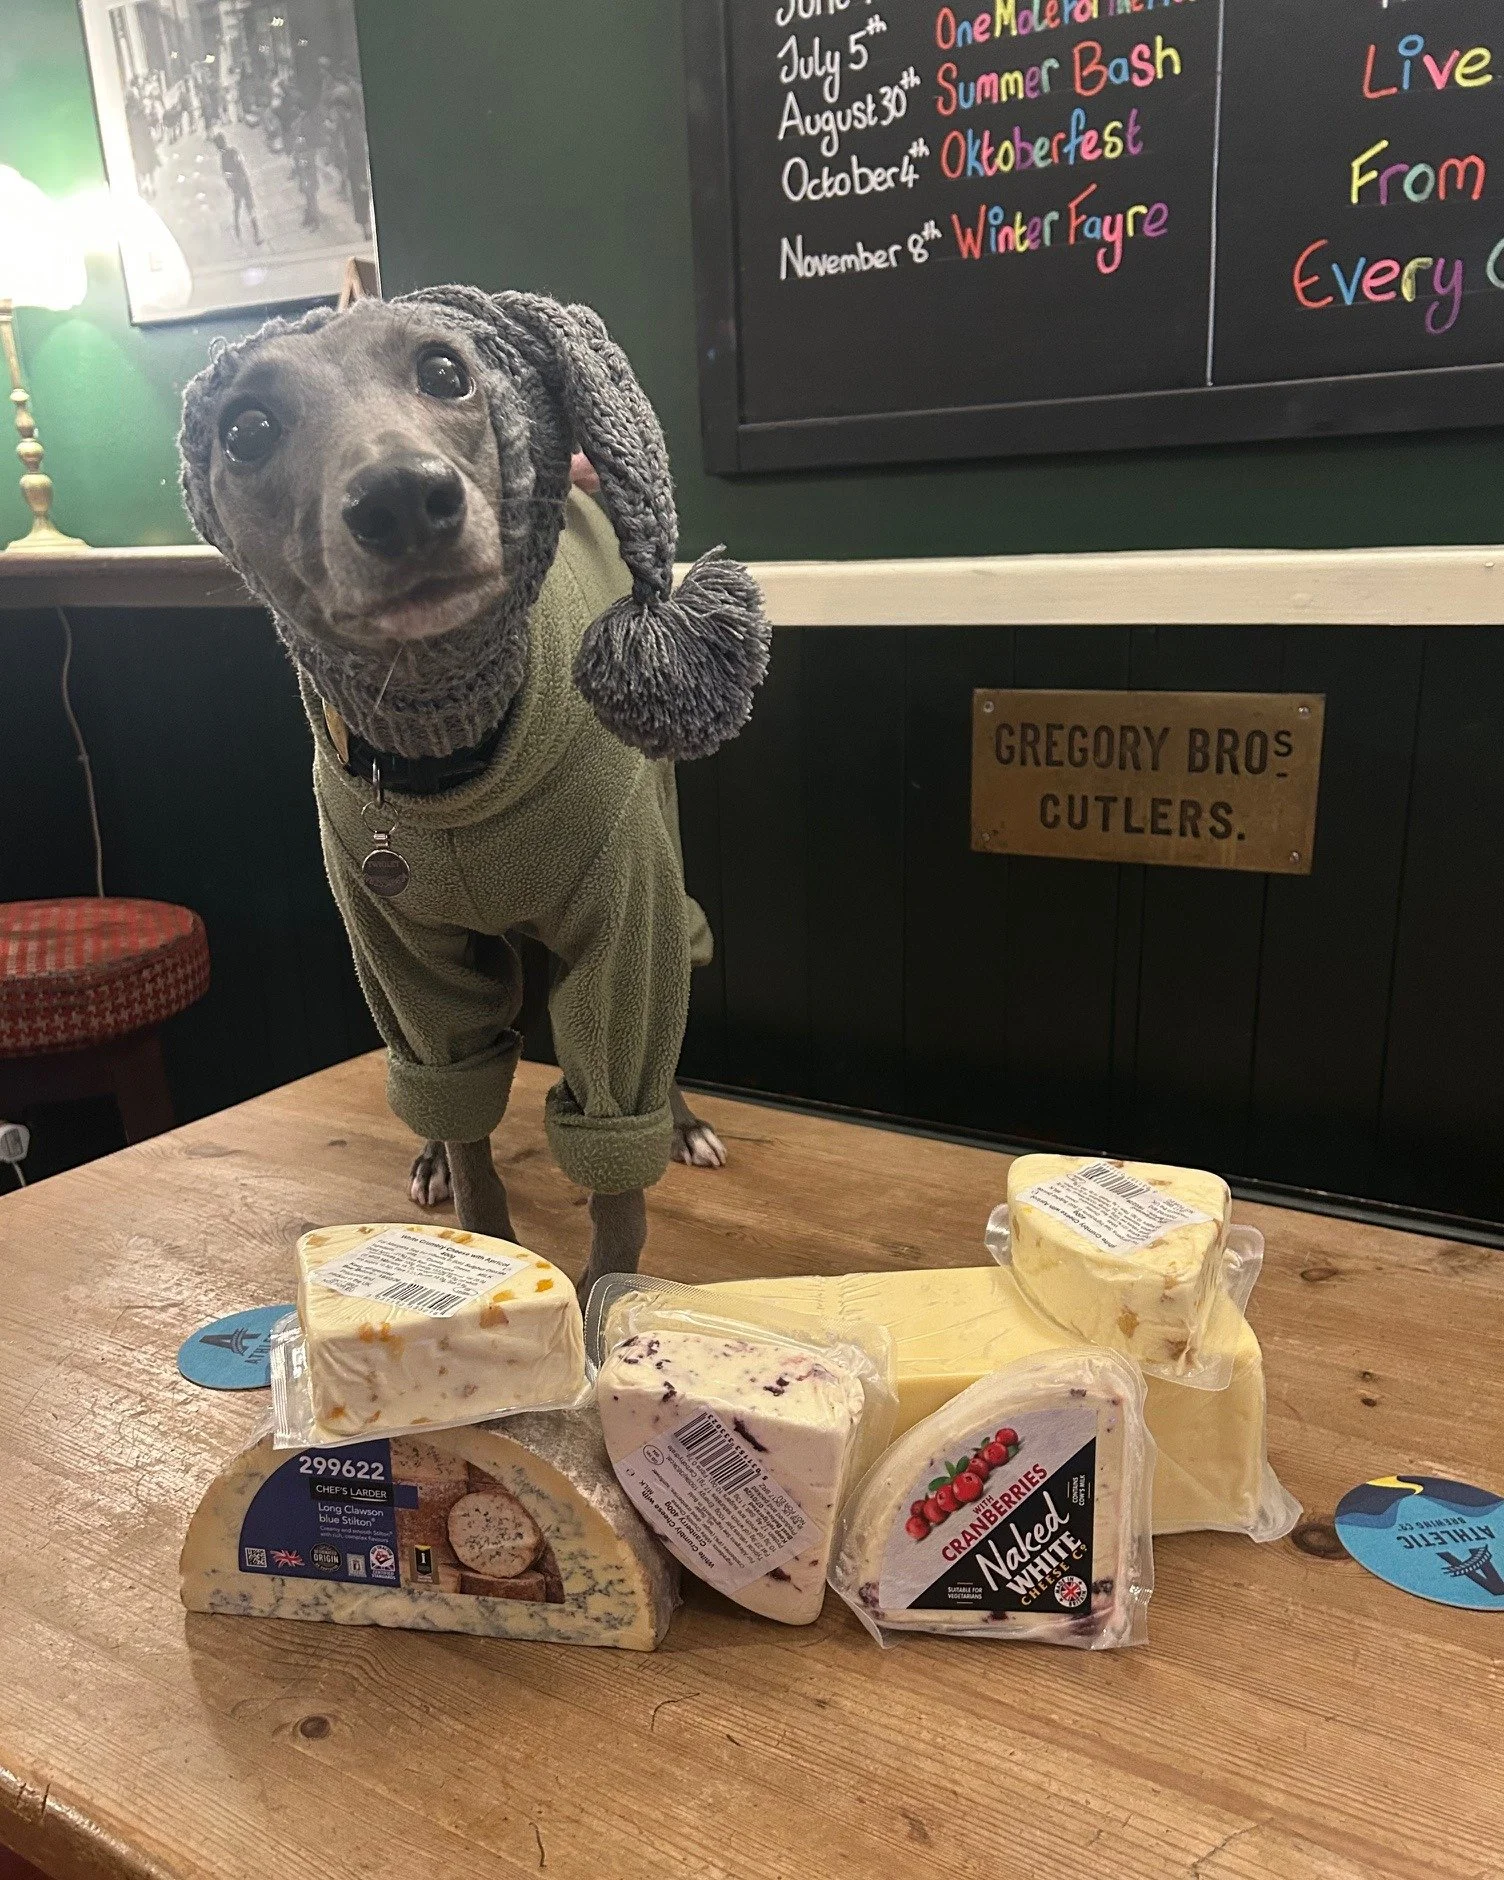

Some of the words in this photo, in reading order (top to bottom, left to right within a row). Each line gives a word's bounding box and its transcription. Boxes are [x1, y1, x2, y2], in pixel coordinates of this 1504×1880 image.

[777, 35, 841, 103] July
[936, 7, 991, 50] One
[1363, 34, 1492, 99] Live
[778, 91, 878, 157] August
[937, 62, 1060, 116] Summer
[1073, 35, 1182, 97] Bash
[782, 155, 899, 201] October
[941, 108, 1144, 178] Oktoberfest
[1350, 139, 1486, 205] From
[780, 235, 901, 280] November
[907, 220, 942, 264] 8th
[951, 204, 1059, 260] Winter
[1068, 184, 1168, 274] Fayre
[1293, 239, 1463, 334] Every
[995, 723, 1171, 771] GREGORY
[1040, 793, 1246, 841] CUTLERS.
[299, 1456, 385, 1480] 299622
[316, 1484, 348, 1495] CHEF'S
[350, 1488, 387, 1499] LARDER
[639, 1489, 656, 1505] with
[972, 1495, 994, 1515] WITH
[318, 1502, 342, 1515] Long
[344, 1505, 384, 1517] Clawson
[319, 1514, 340, 1524] blue
[652, 1503, 676, 1528] Cheese
[662, 1500, 681, 1518] 400g
[942, 1463, 1048, 1561] CRANBERRIES
[1415, 1516, 1467, 1529] BREWING
[672, 1525, 700, 1552] Crumbly
[677, 1516, 708, 1547] Cranberry
[773, 1528, 788, 1543] Keep
[975, 1490, 1070, 1592] Naked
[1396, 1525, 1496, 1549] ATHLETIC
[314, 1553, 339, 1563] ORIGIN
[696, 1550, 715, 1569] White
[1006, 1531, 1082, 1595] WHITE
[1022, 1561, 1070, 1606] CHEESE
